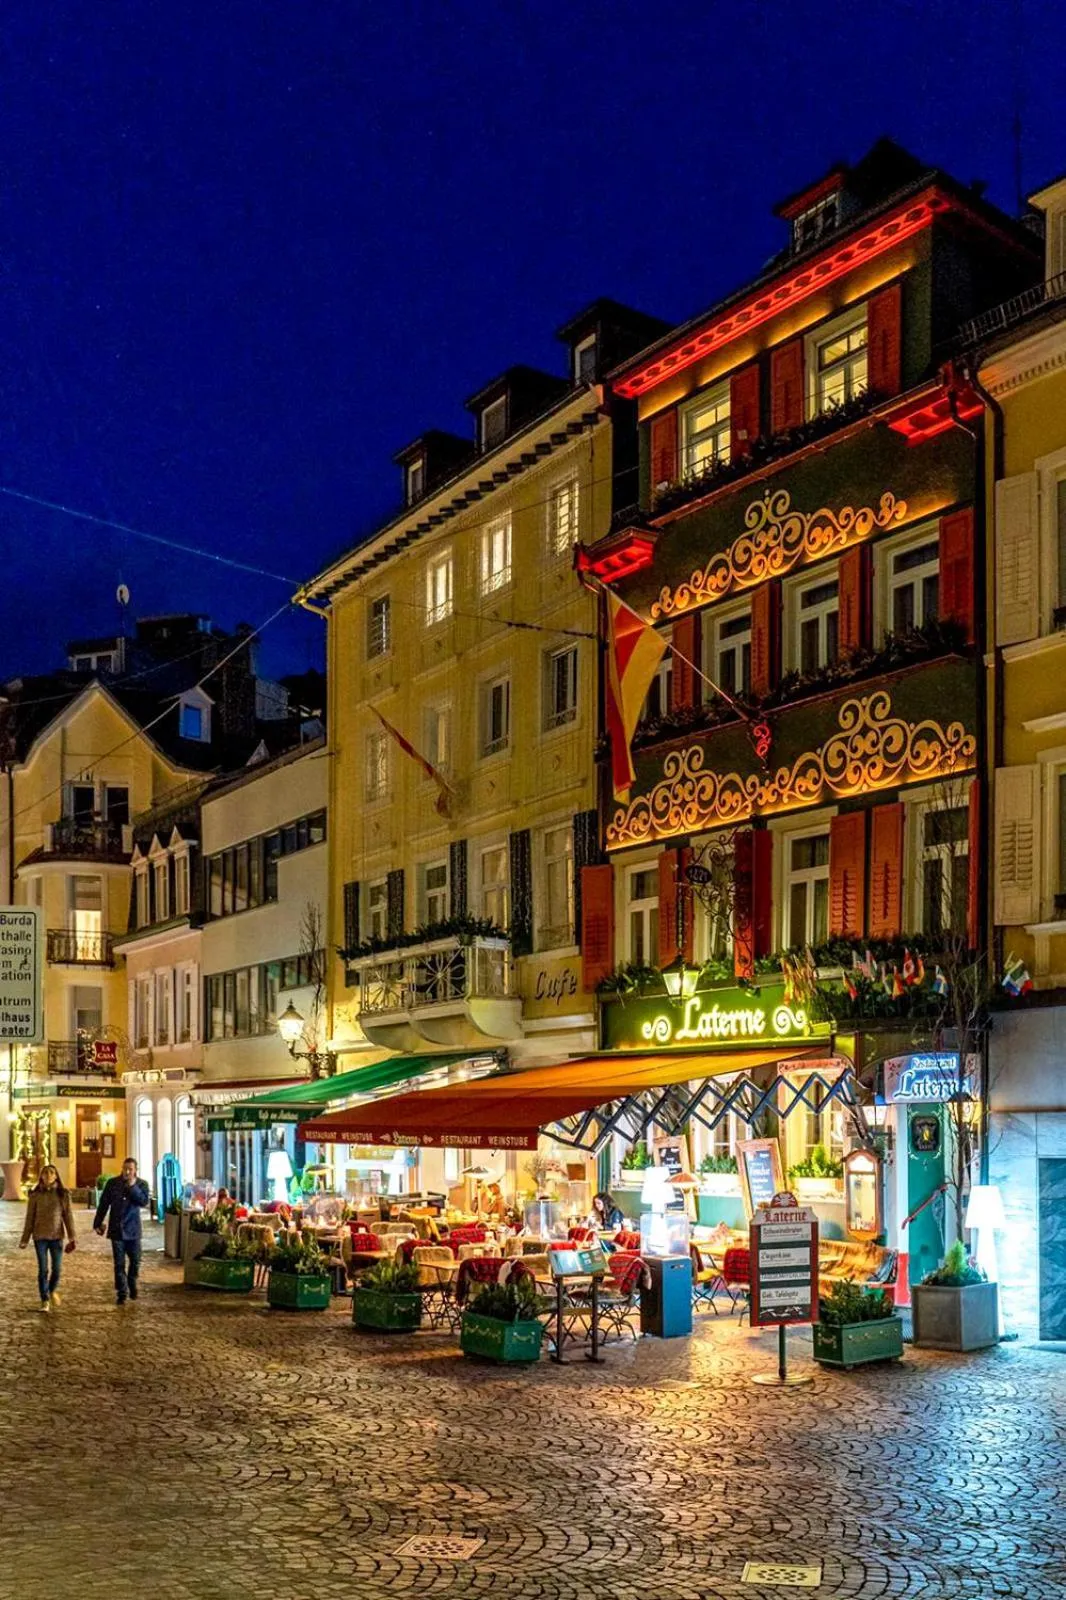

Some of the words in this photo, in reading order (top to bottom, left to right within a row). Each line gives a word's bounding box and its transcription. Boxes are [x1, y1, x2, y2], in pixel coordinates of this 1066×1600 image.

[0, 914, 32, 925] Burda
[1, 930, 32, 941] thalle
[1, 970, 31, 980] ation
[676, 996, 766, 1040] Laterne
[1, 1025, 30, 1035] eater
[893, 1069, 970, 1099] Latern
[305, 1131, 337, 1139] RESTAURANT
[440, 1135, 482, 1145] RESTAURANT
[487, 1136, 528, 1146] WEINSTUBE
[764, 1210, 807, 1222] Laterne
